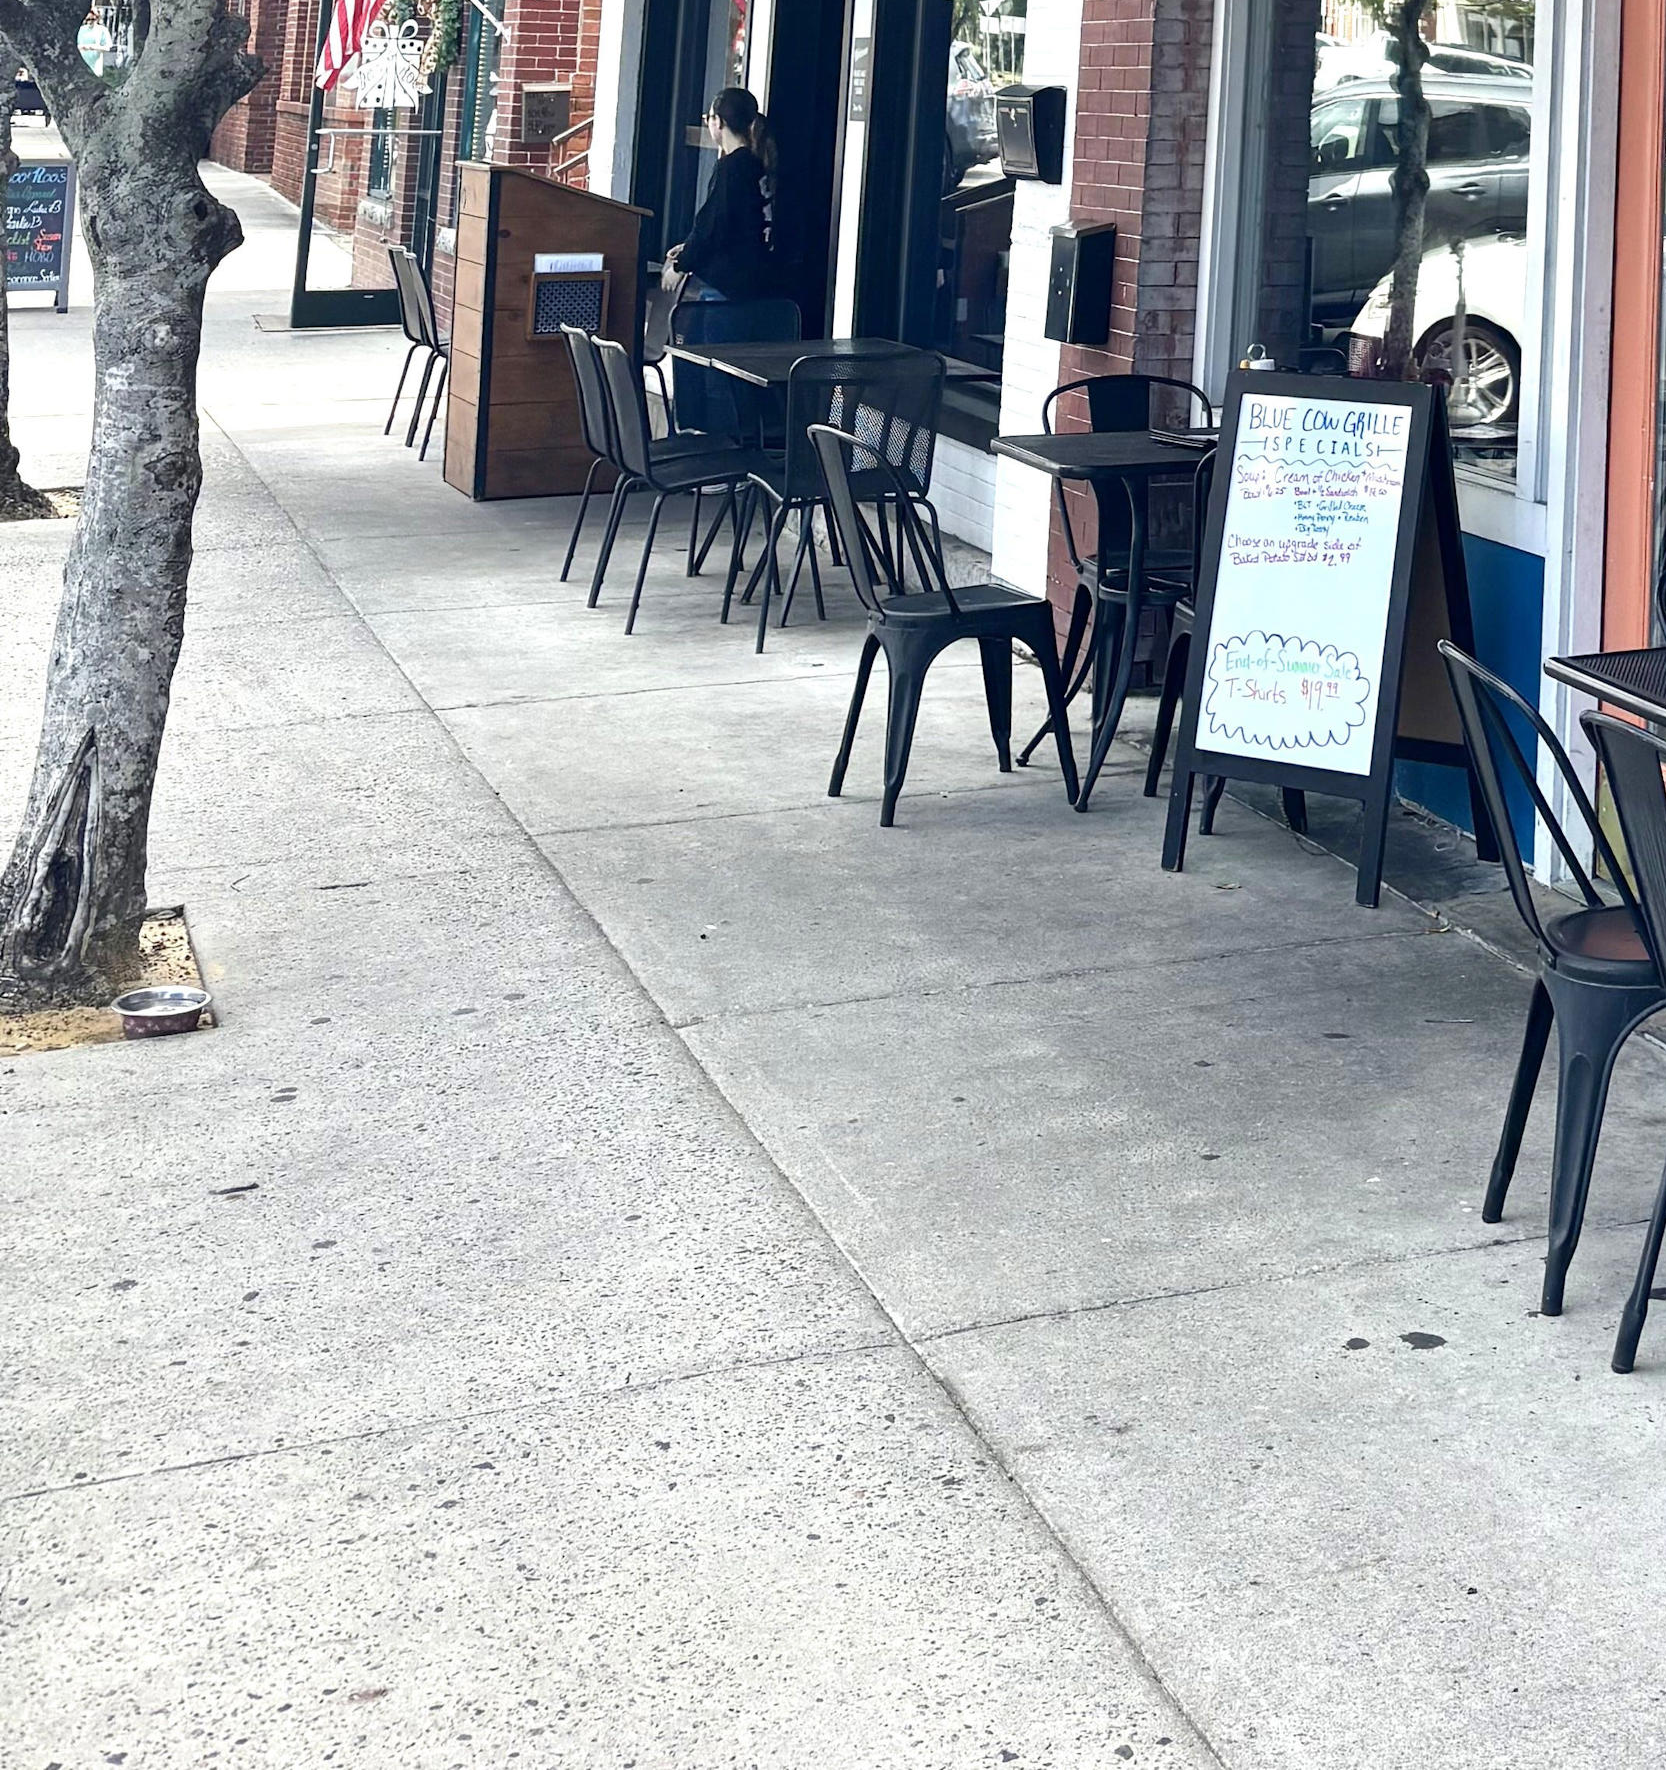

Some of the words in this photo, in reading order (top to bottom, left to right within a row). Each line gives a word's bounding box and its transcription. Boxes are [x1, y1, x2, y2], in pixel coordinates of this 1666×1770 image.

[1250, 402, 1296, 430] BLUE
[1302, 408, 1340, 432] COW
[1343, 411, 1404, 439] GRILLE
[1272, 436, 1374, 457] SPECIALS
[1275, 465, 1309, 484] Cream
[1325, 469, 1360, 484] Chicken
[1228, 534, 1260, 548] Choose
[1279, 537, 1318, 552] upgrade
[1323, 537, 1344, 550] side
[1324, 652, 1352, 680] Sale
[1224, 677, 1287, 704] T-Shirts
